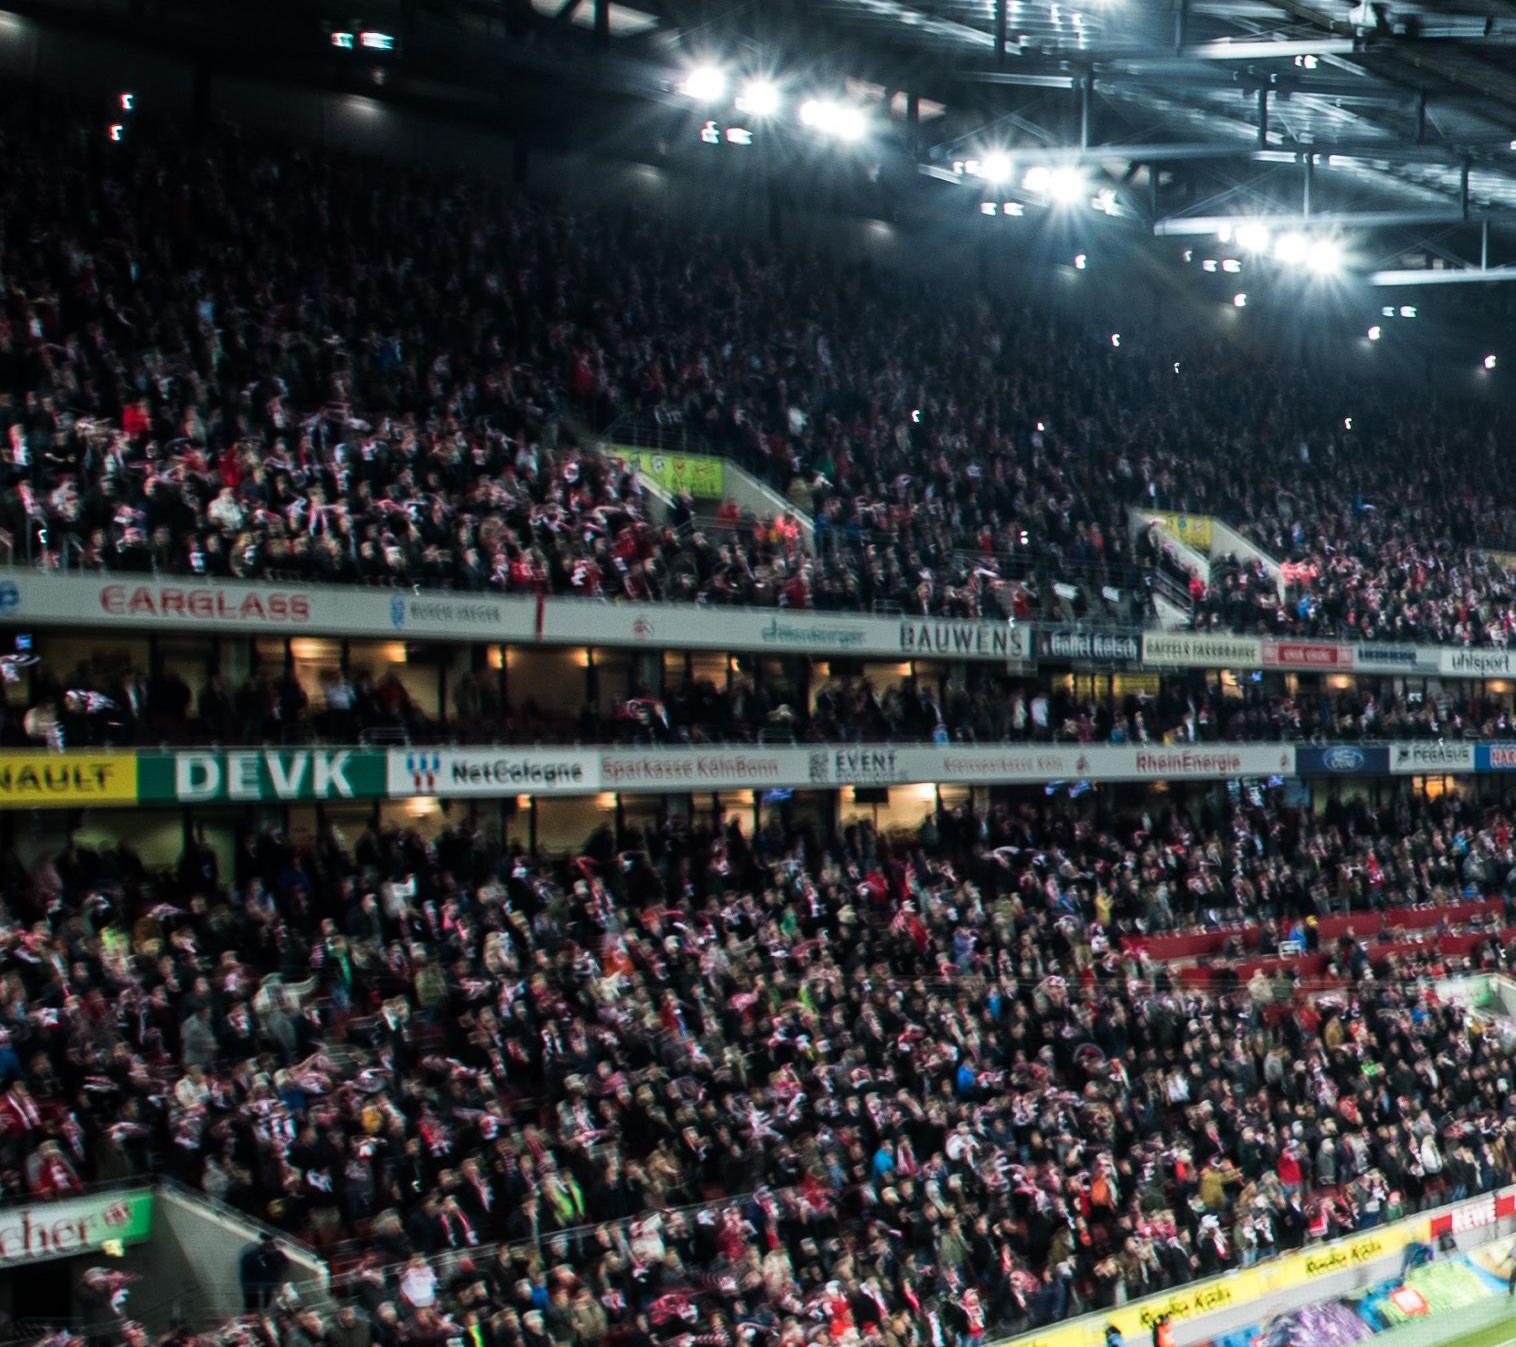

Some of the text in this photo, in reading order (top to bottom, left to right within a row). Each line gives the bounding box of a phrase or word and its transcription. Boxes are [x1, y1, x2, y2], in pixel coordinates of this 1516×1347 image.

[901, 621, 1023, 657] BAUWENS
[1451, 651, 1511, 677] uhlsport
[452, 759, 584, 786] NetCologne
[836, 750, 897, 770] EVENT
[1136, 752, 1241, 777] RheinEnergie
[175, 751, 356, 801] DEVK
[1451, 1196, 1497, 1233] REWE
[1351, 1239, 1382, 1262] Köln
[1194, 1282, 1233, 1309] Köln
